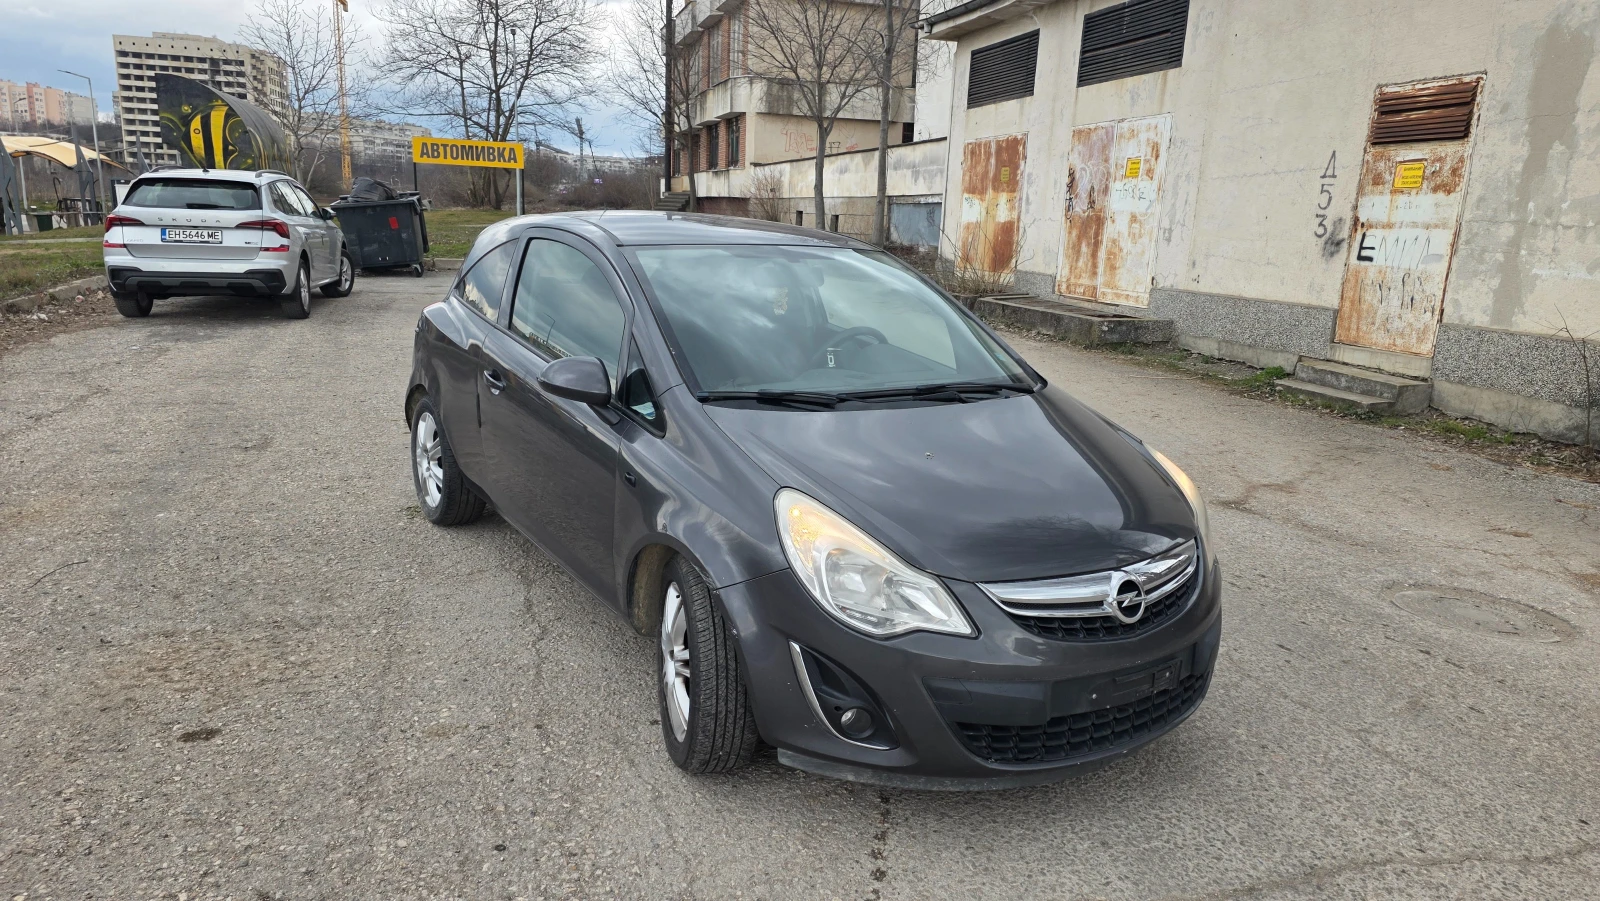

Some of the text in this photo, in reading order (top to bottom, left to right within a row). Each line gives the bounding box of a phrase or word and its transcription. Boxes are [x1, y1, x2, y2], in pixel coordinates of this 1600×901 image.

[419, 142, 518, 163] АВТОМИВКА
[168, 230, 220, 240] EH 5646 ME
